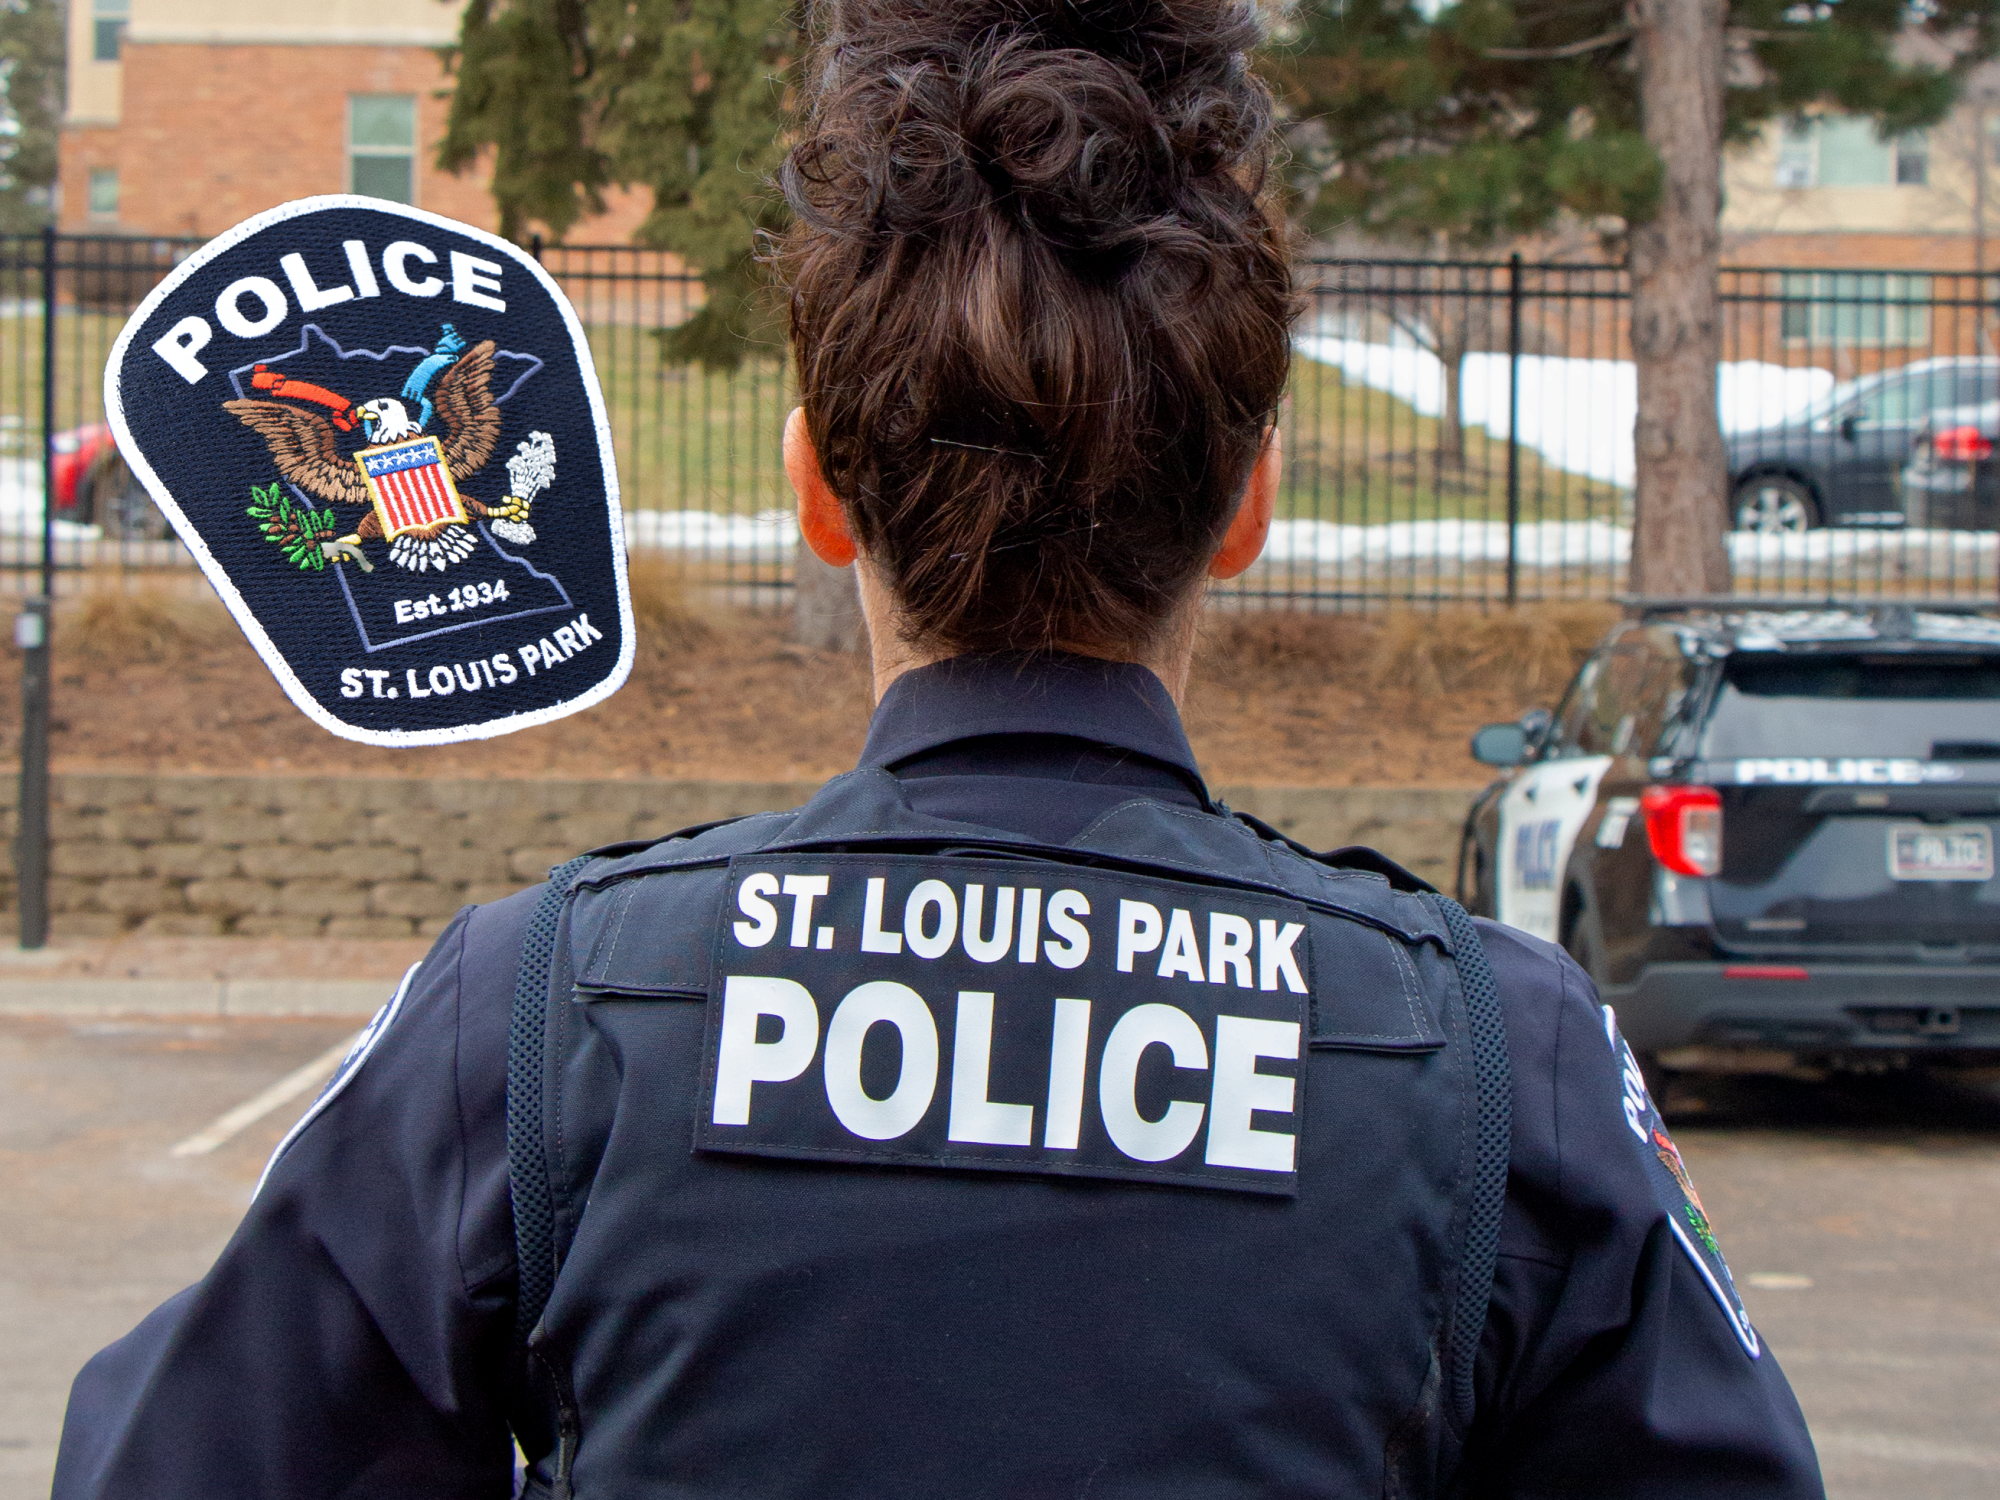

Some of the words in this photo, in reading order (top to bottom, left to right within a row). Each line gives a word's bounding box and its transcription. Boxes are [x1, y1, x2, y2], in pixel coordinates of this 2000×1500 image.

[1736, 759, 1921, 784] POLICE
[732, 872, 834, 950] ST.
[861, 878, 1091, 969] LOUIS
[1116, 898, 1309, 994] PARK
[712, 975, 1301, 1173] POLICE
